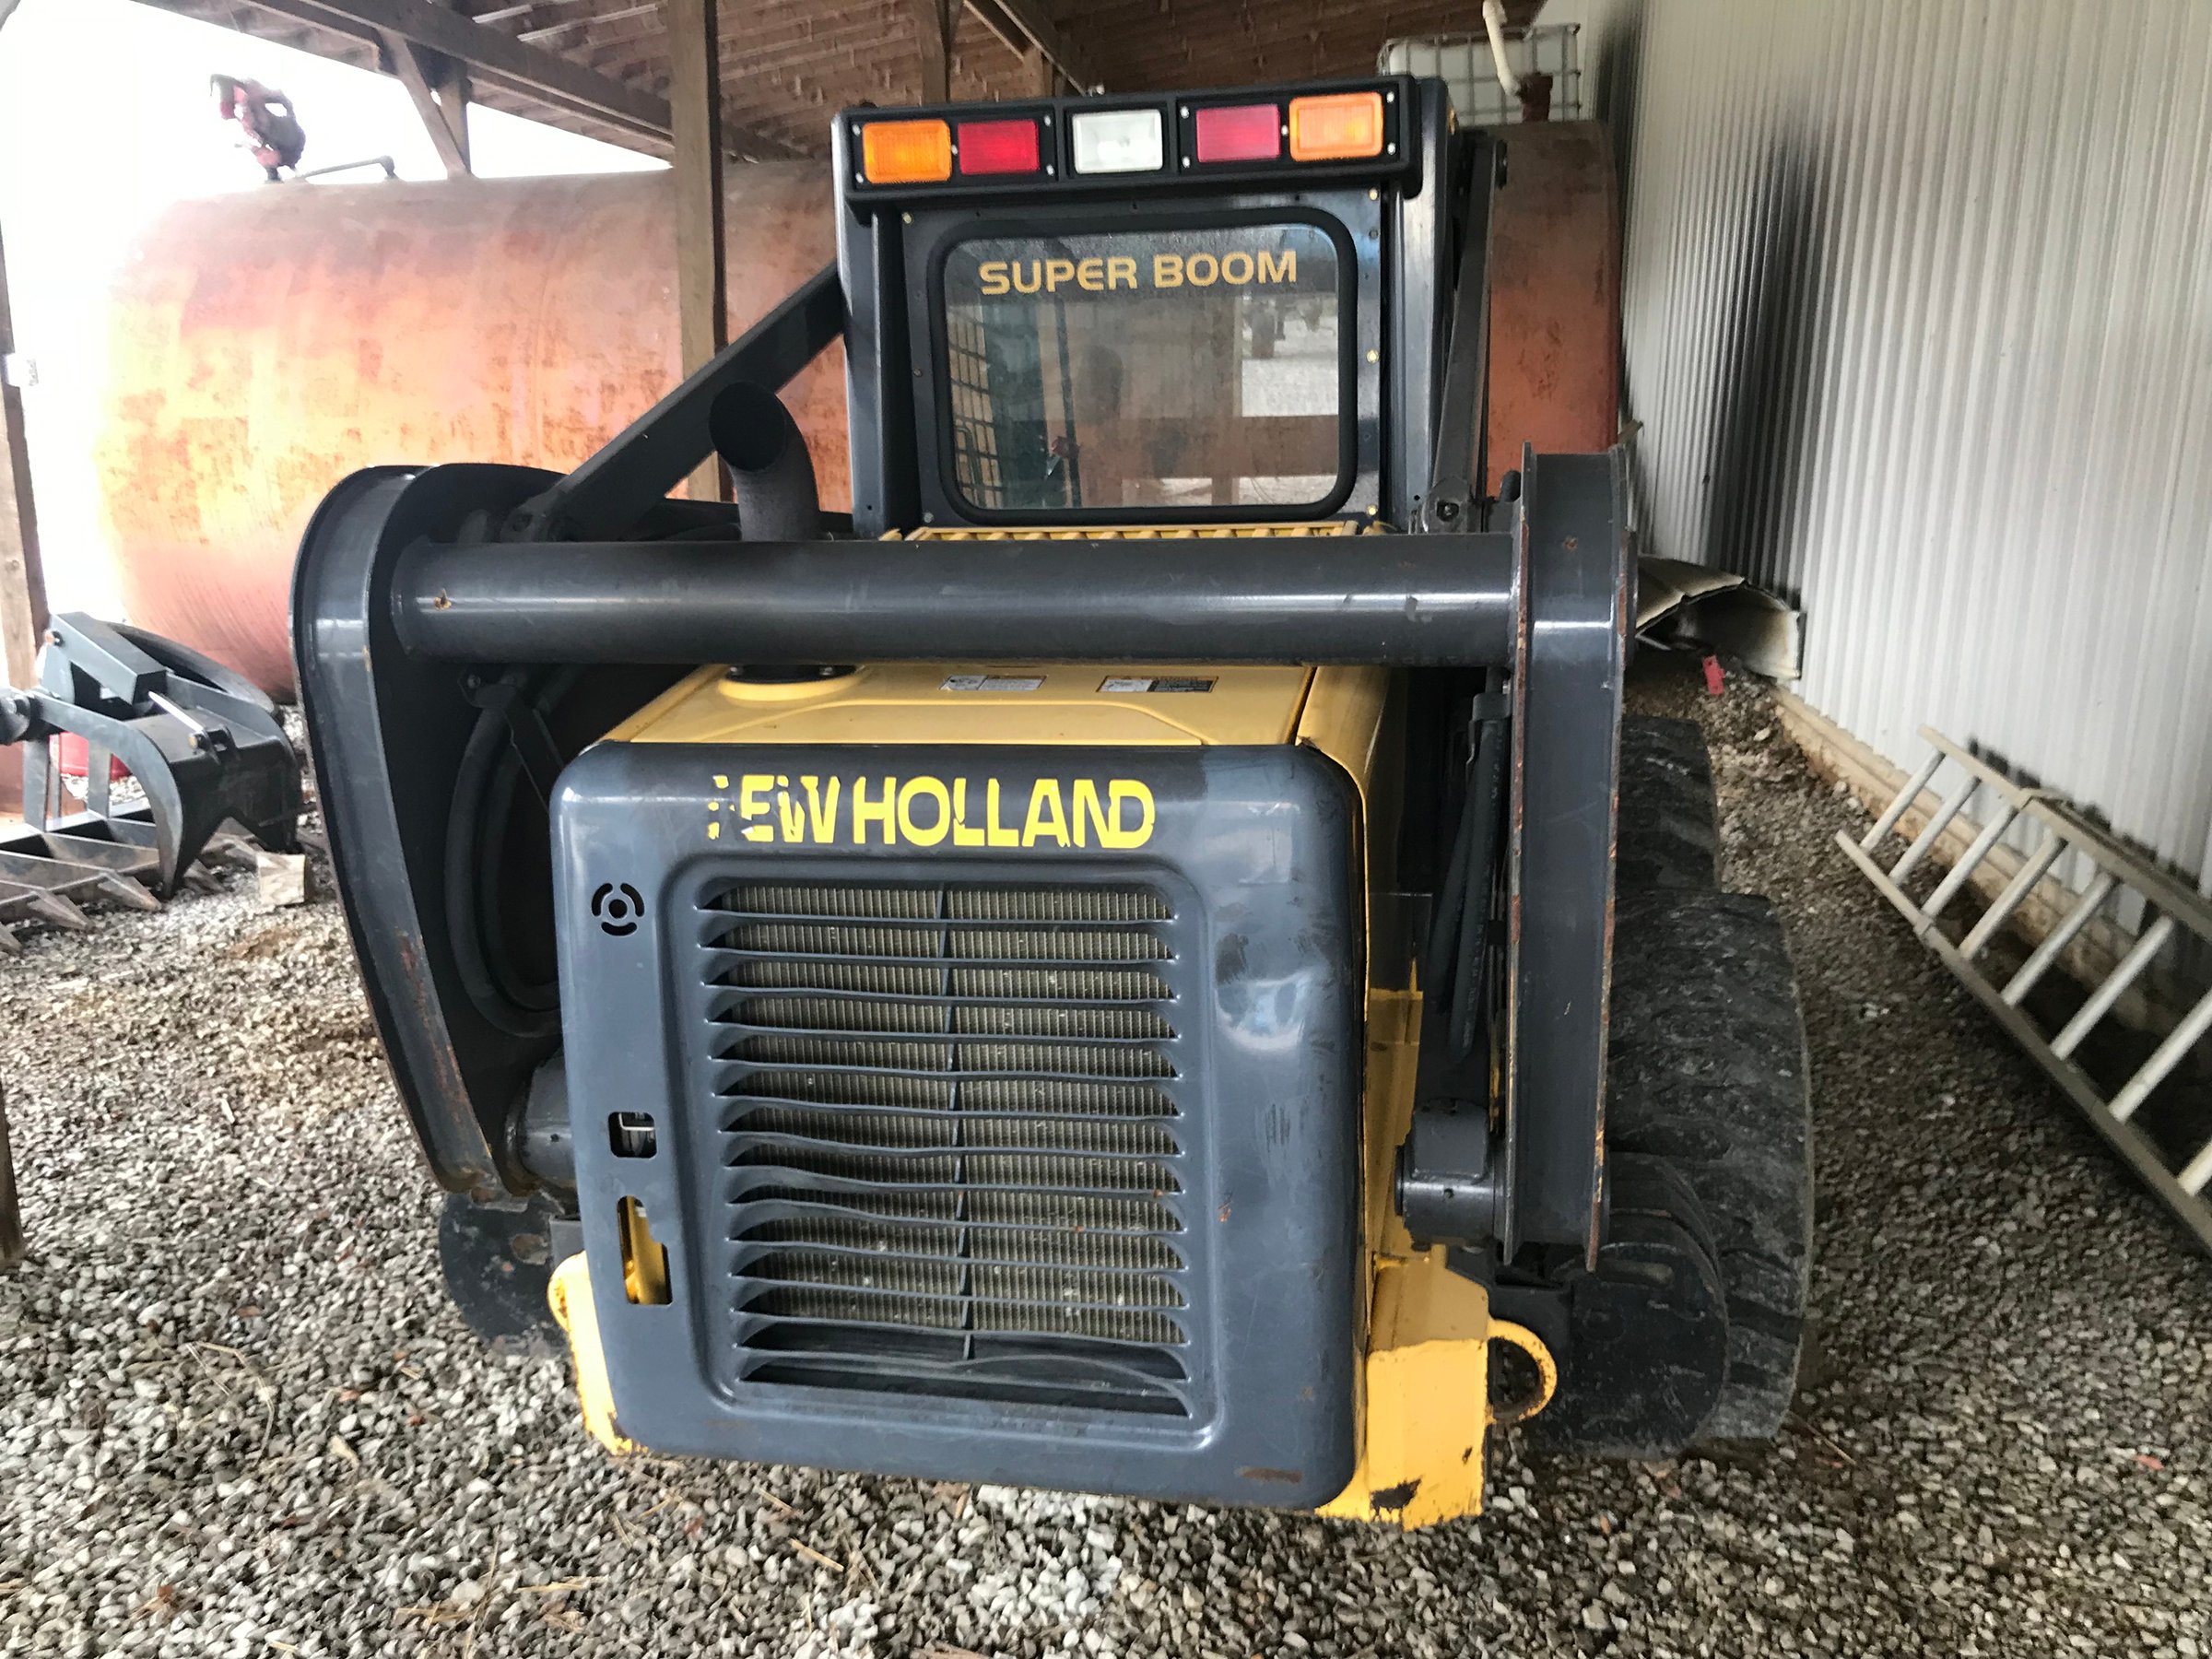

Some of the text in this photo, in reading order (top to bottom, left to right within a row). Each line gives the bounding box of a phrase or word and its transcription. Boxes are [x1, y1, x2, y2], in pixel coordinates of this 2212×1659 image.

[978, 249, 1298, 296] SUPER BOOM
[707, 774, 1156, 849] EW HOLLAND
